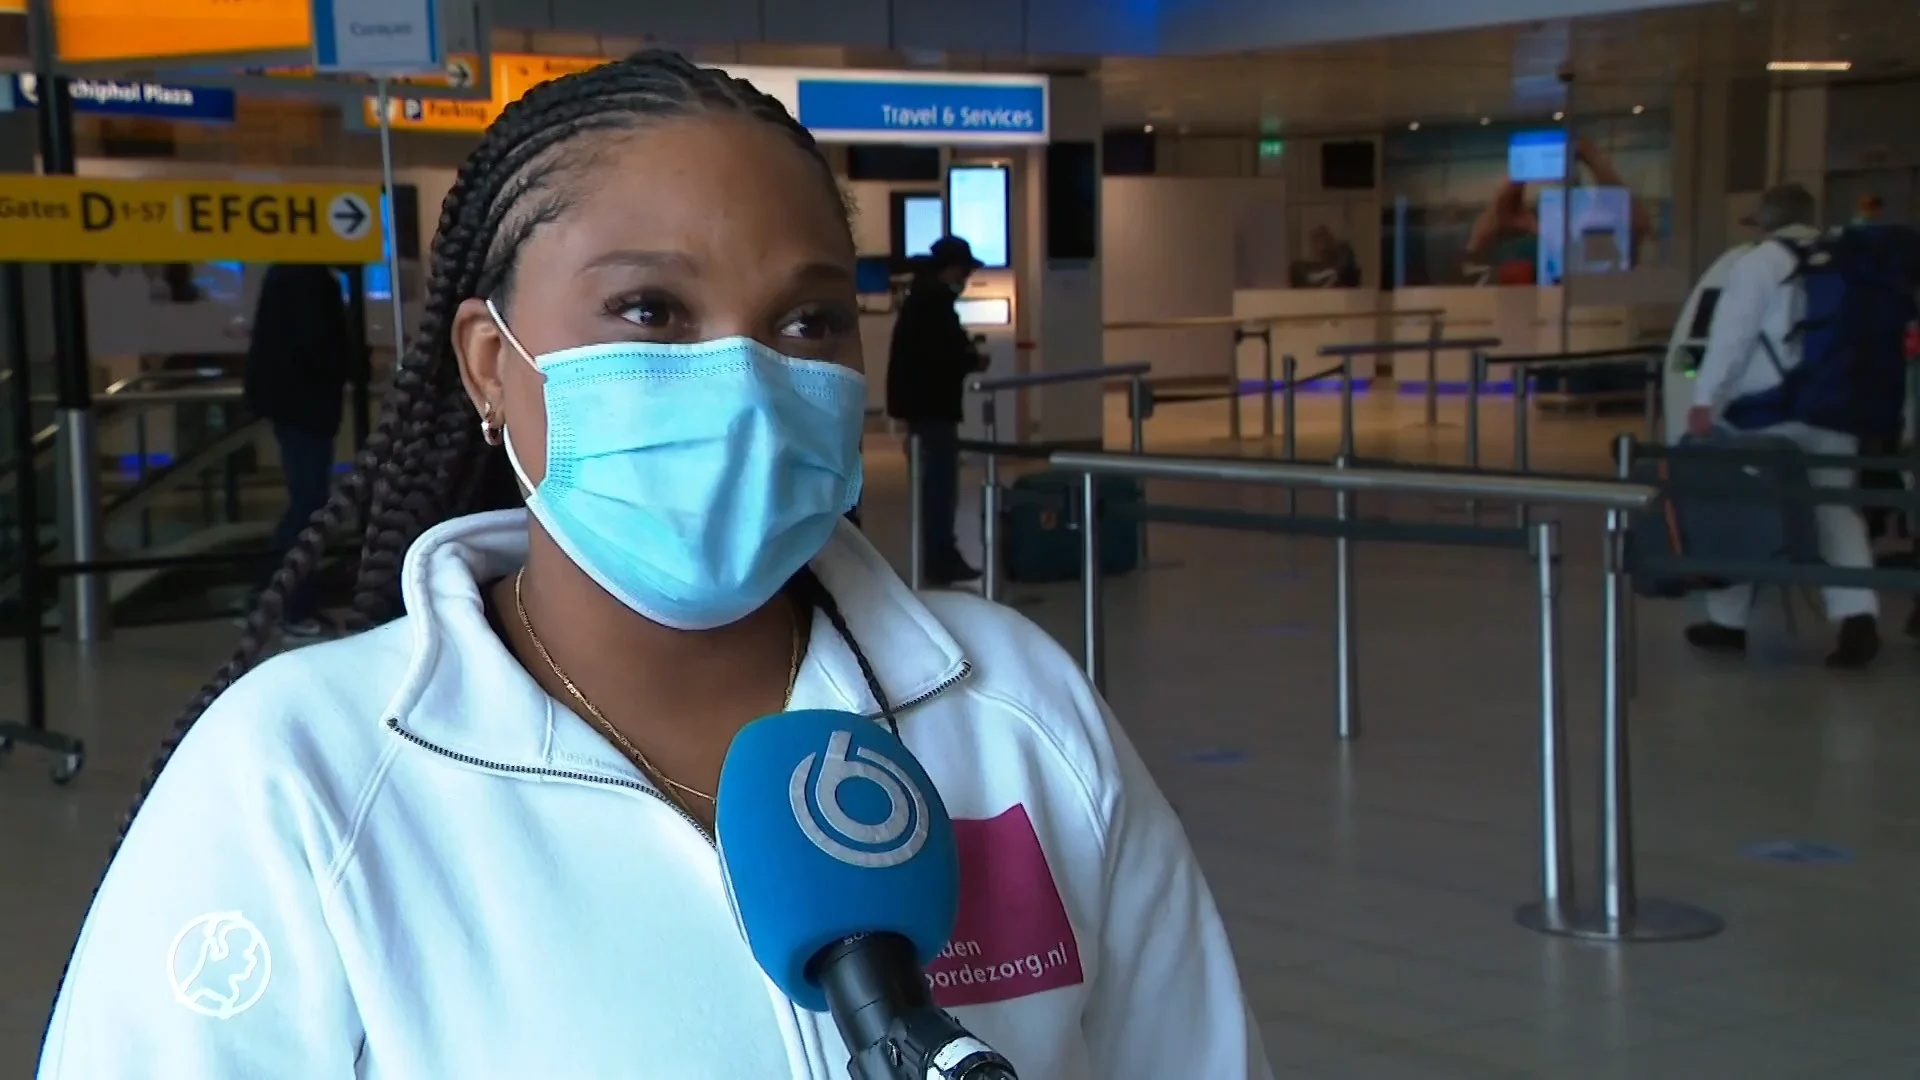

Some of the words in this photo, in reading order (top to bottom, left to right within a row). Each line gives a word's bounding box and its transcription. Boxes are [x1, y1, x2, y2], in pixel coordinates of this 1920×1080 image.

[68, 79, 141, 104] chiphol
[142, 83, 194, 106] Plaza
[428, 101, 488, 123] Parking
[882, 104, 938, 126] Travel
[942, 105, 956, 127] &
[960, 106, 1034, 128] Services
[79, 192, 115, 232] D
[121, 202, 167, 221] 1-57
[189, 194, 318, 234] EFGH
[937, 940, 982, 959] den
[924, 941, 1068, 989] oordezorg.nl
